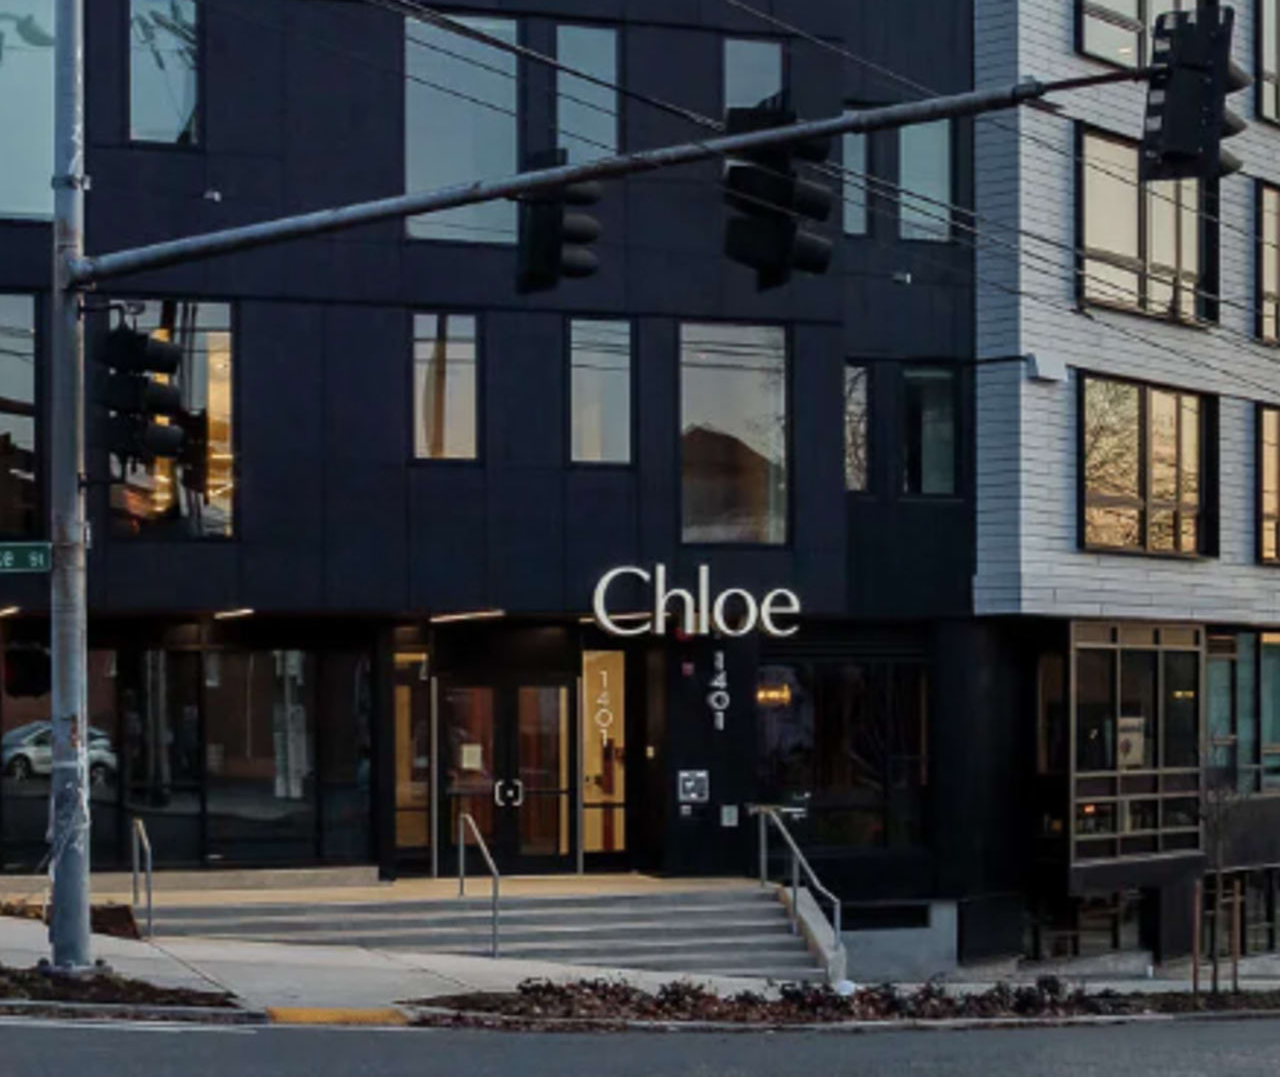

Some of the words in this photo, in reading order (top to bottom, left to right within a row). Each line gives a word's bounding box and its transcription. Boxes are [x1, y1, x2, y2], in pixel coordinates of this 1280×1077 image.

[593, 563, 801, 637] Chloe
[594, 671, 613, 746] 1401
[707, 651, 730, 731] 1401
